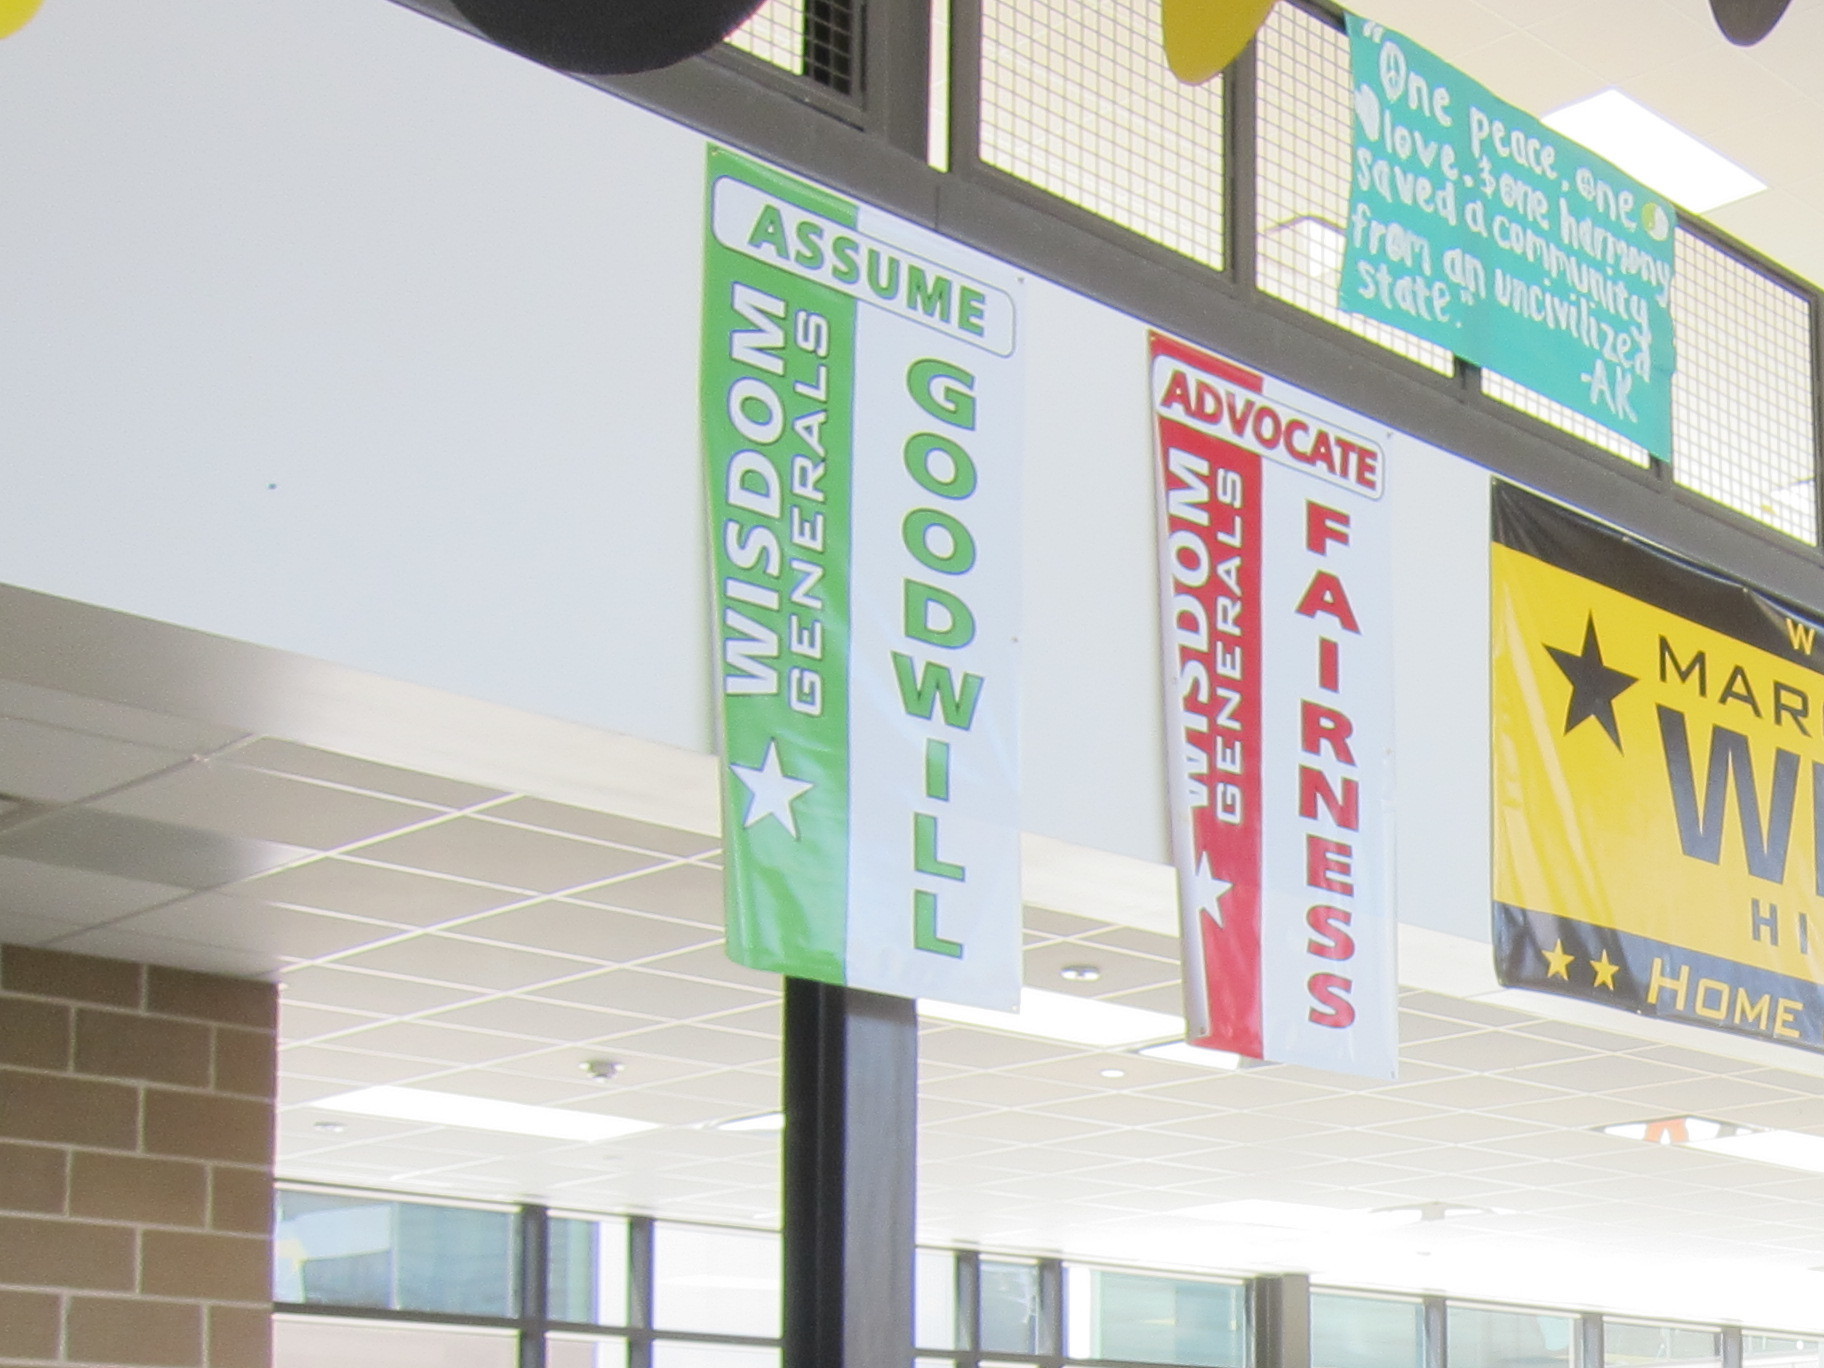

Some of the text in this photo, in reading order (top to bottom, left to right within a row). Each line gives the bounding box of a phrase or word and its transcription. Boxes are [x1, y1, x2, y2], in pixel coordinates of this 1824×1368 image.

[747, 202, 987, 339] ASSUME
[1352, 202, 1651, 383] from an uncivilized
[1356, 147, 1653, 345] saved a community
[1499, 172, 1551, 231] one
[1558, 196, 1672, 308] harmony
[725, 280, 789, 699] WISDOM
[788, 308, 832, 717] GENERALS
[1160, 368, 1379, 492] ADVOCATE
[890, 356, 986, 960] GOODWILL
[1167, 446, 1212, 808] WISDOM
[1215, 467, 1243, 826] GENERALS
[1295, 498, 1362, 1029] FAIRNESS
